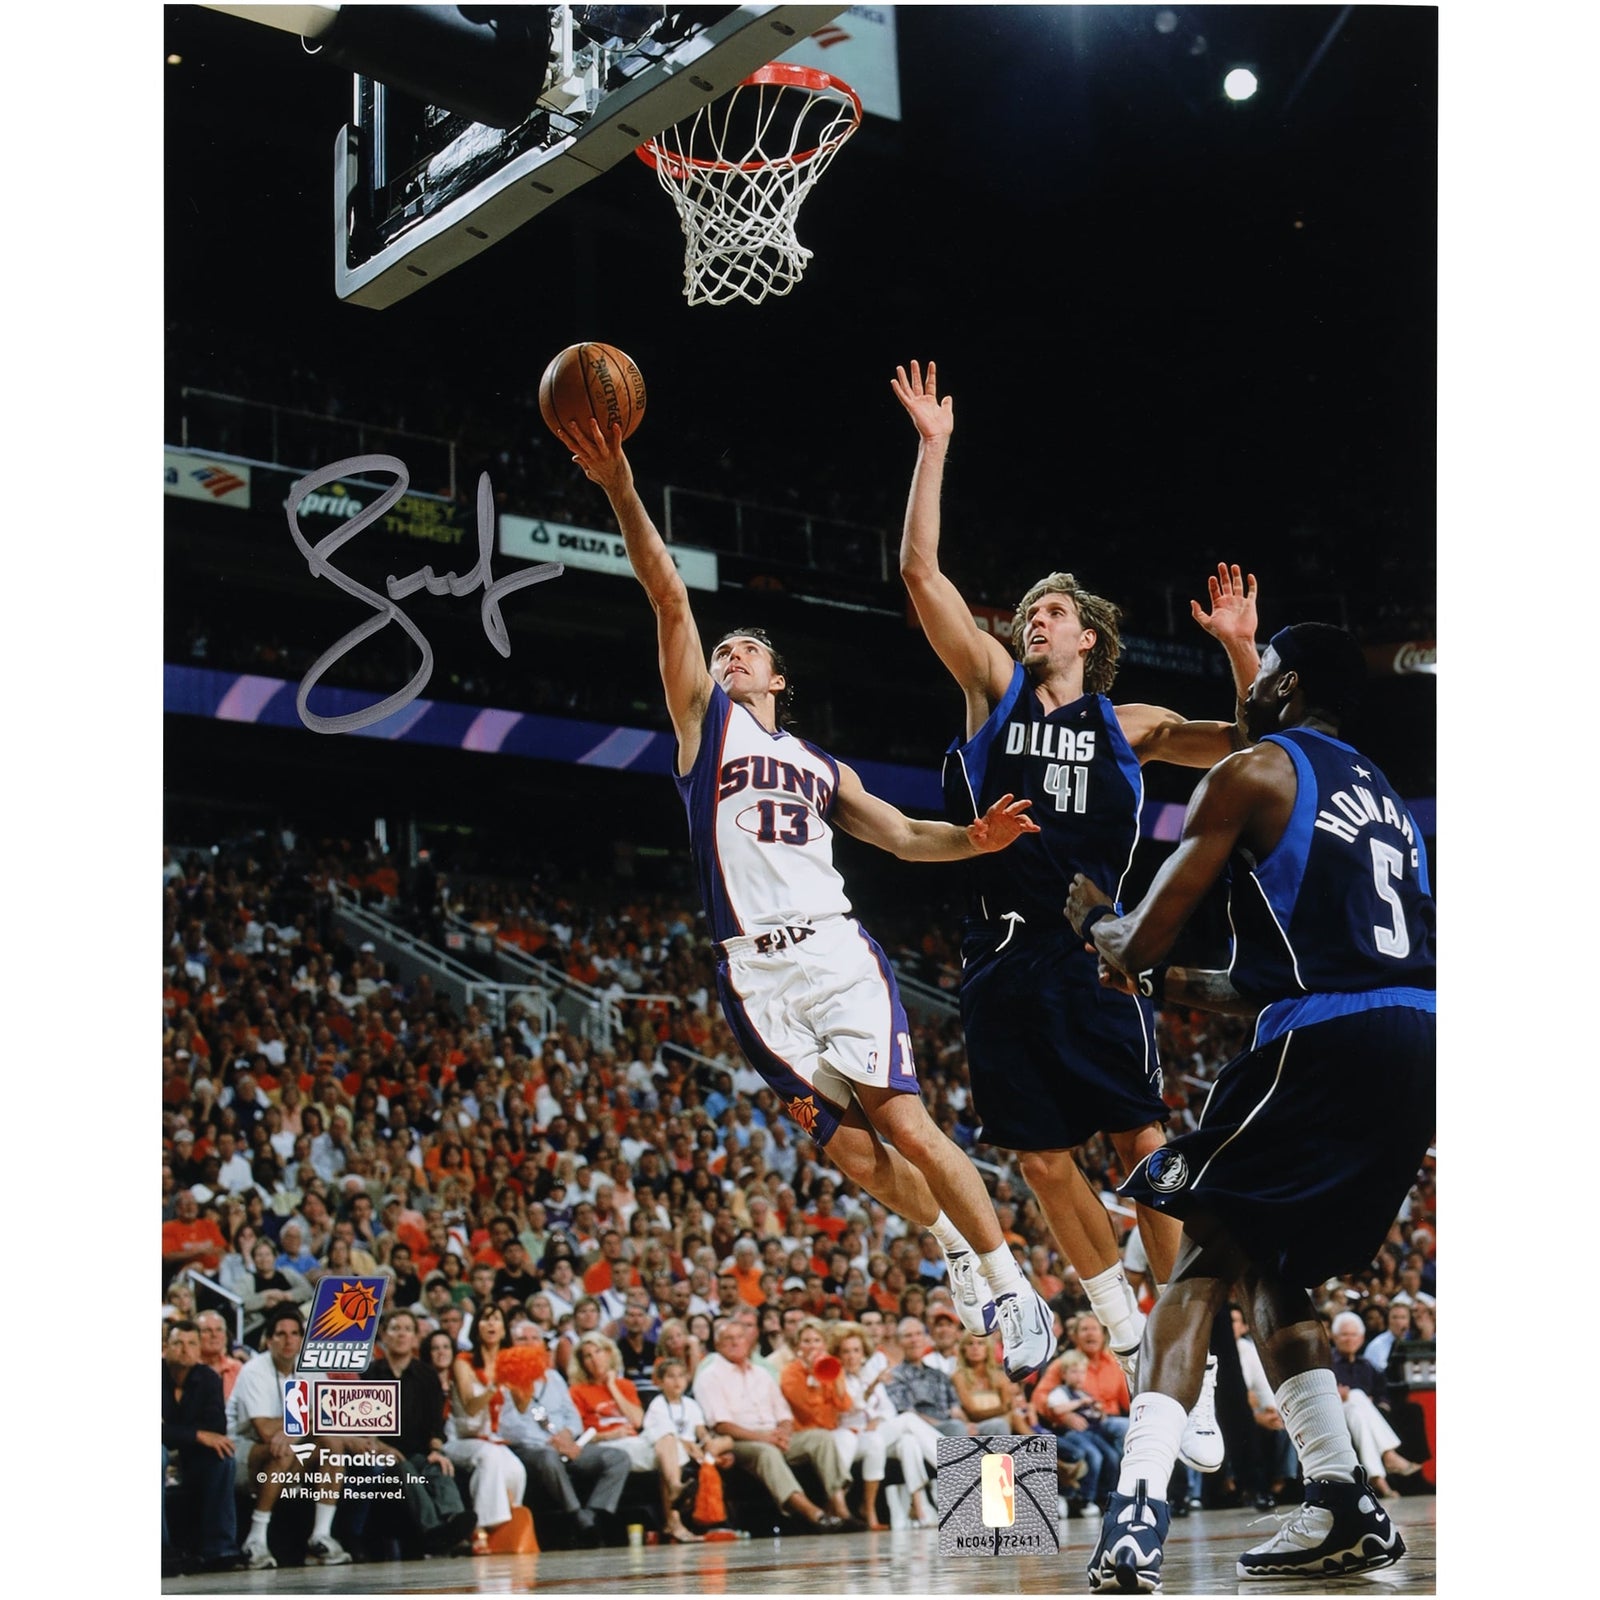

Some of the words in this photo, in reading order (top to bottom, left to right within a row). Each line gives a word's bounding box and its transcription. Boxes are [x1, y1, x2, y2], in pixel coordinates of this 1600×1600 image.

[557, 532, 609, 556] DELTA
[719, 755, 831, 817] SUNS
[1043, 763, 1088, 814] 41
[757, 799, 809, 846] 13
[1370, 837, 1410, 959] 5
[1138, 968, 1154, 997] 5
